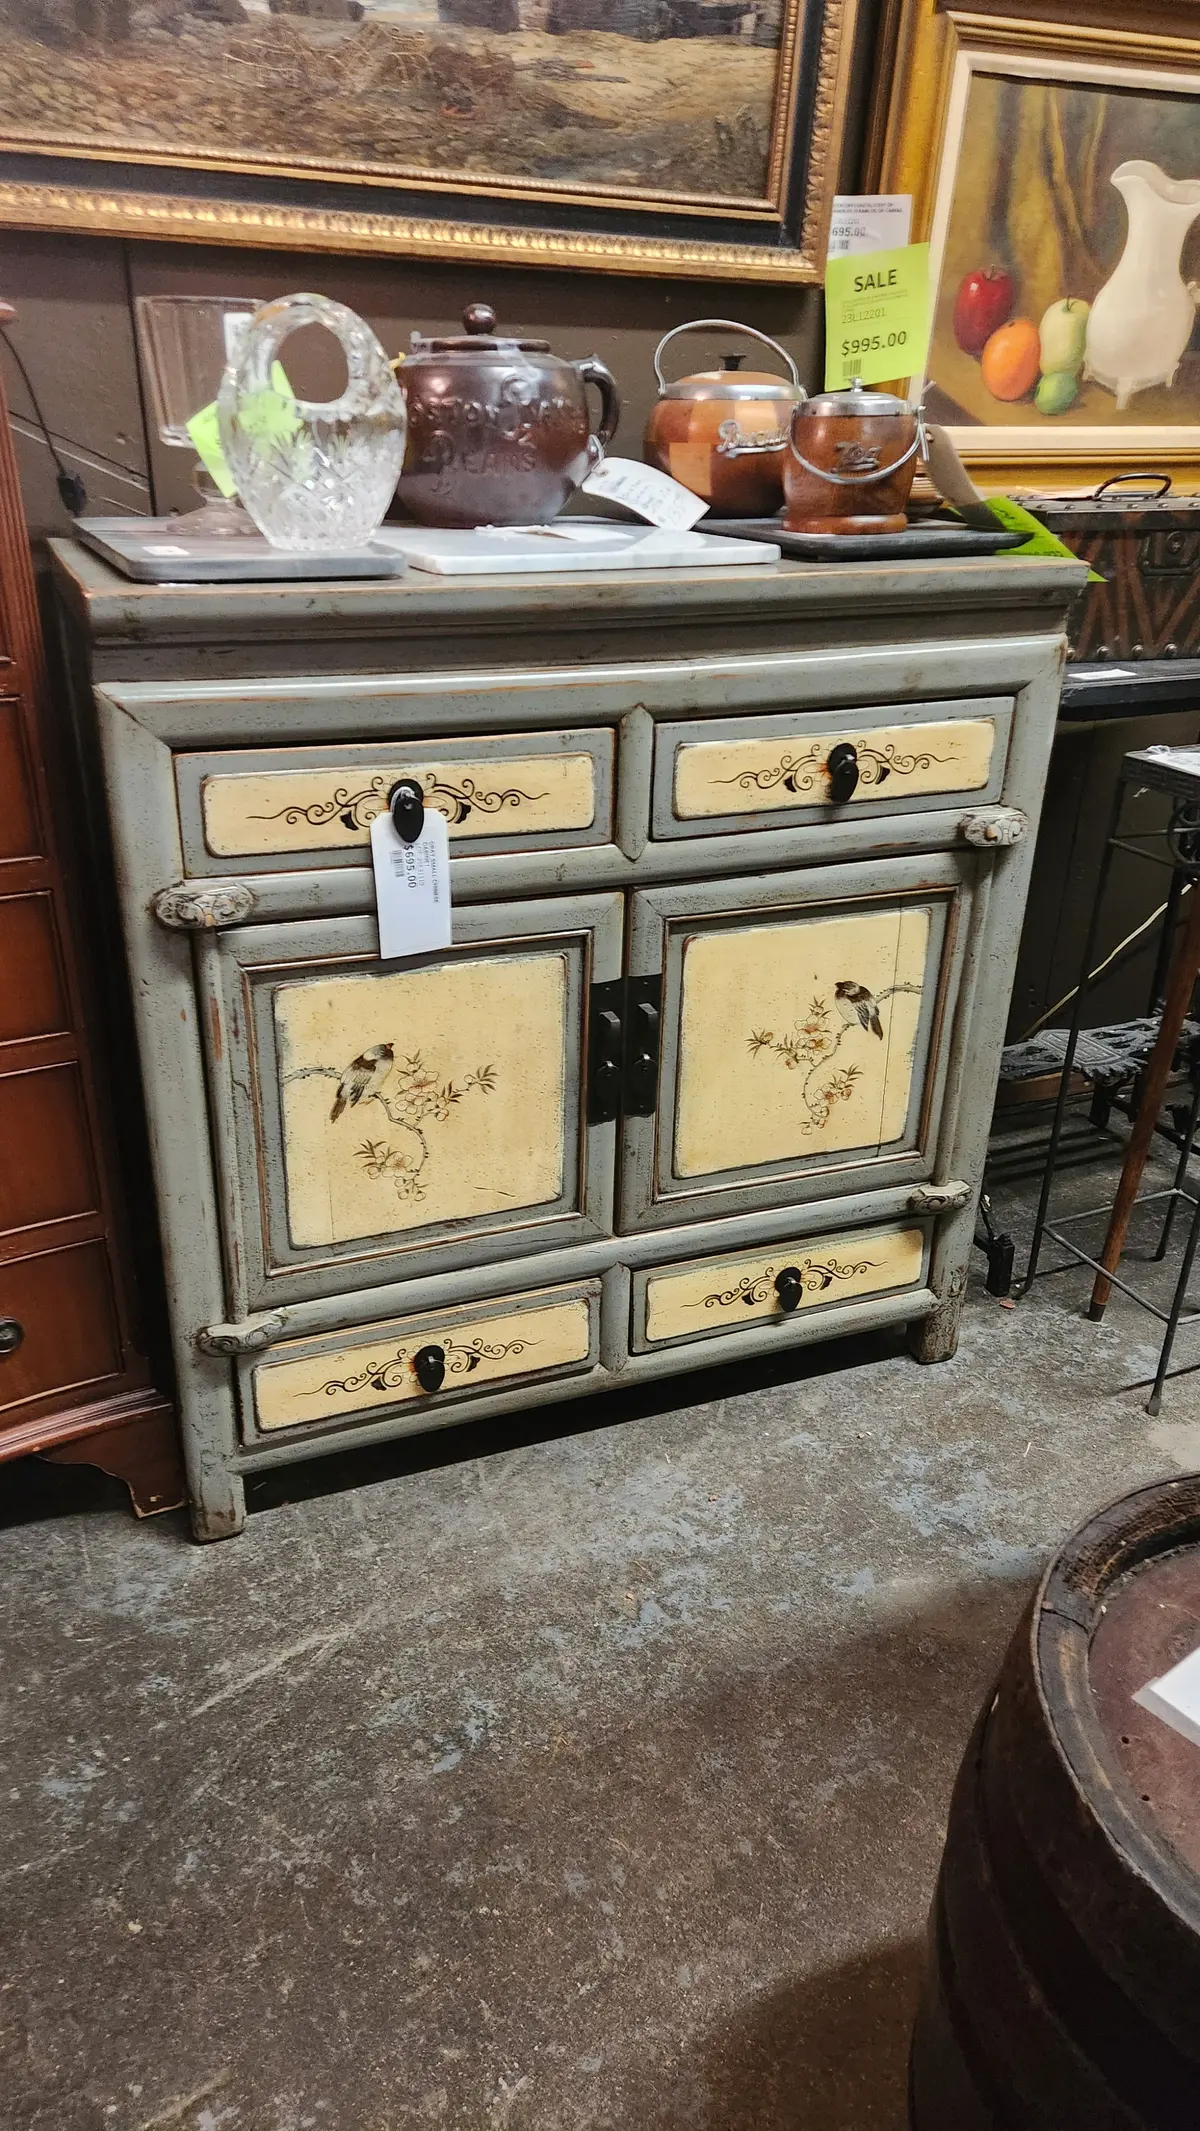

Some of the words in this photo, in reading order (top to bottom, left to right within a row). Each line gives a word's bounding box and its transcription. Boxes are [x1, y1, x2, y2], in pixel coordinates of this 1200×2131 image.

[854, 268, 898, 293] SALE
[841, 330, 908, 357] $995.00
[403, 844, 417, 889] $695.00
